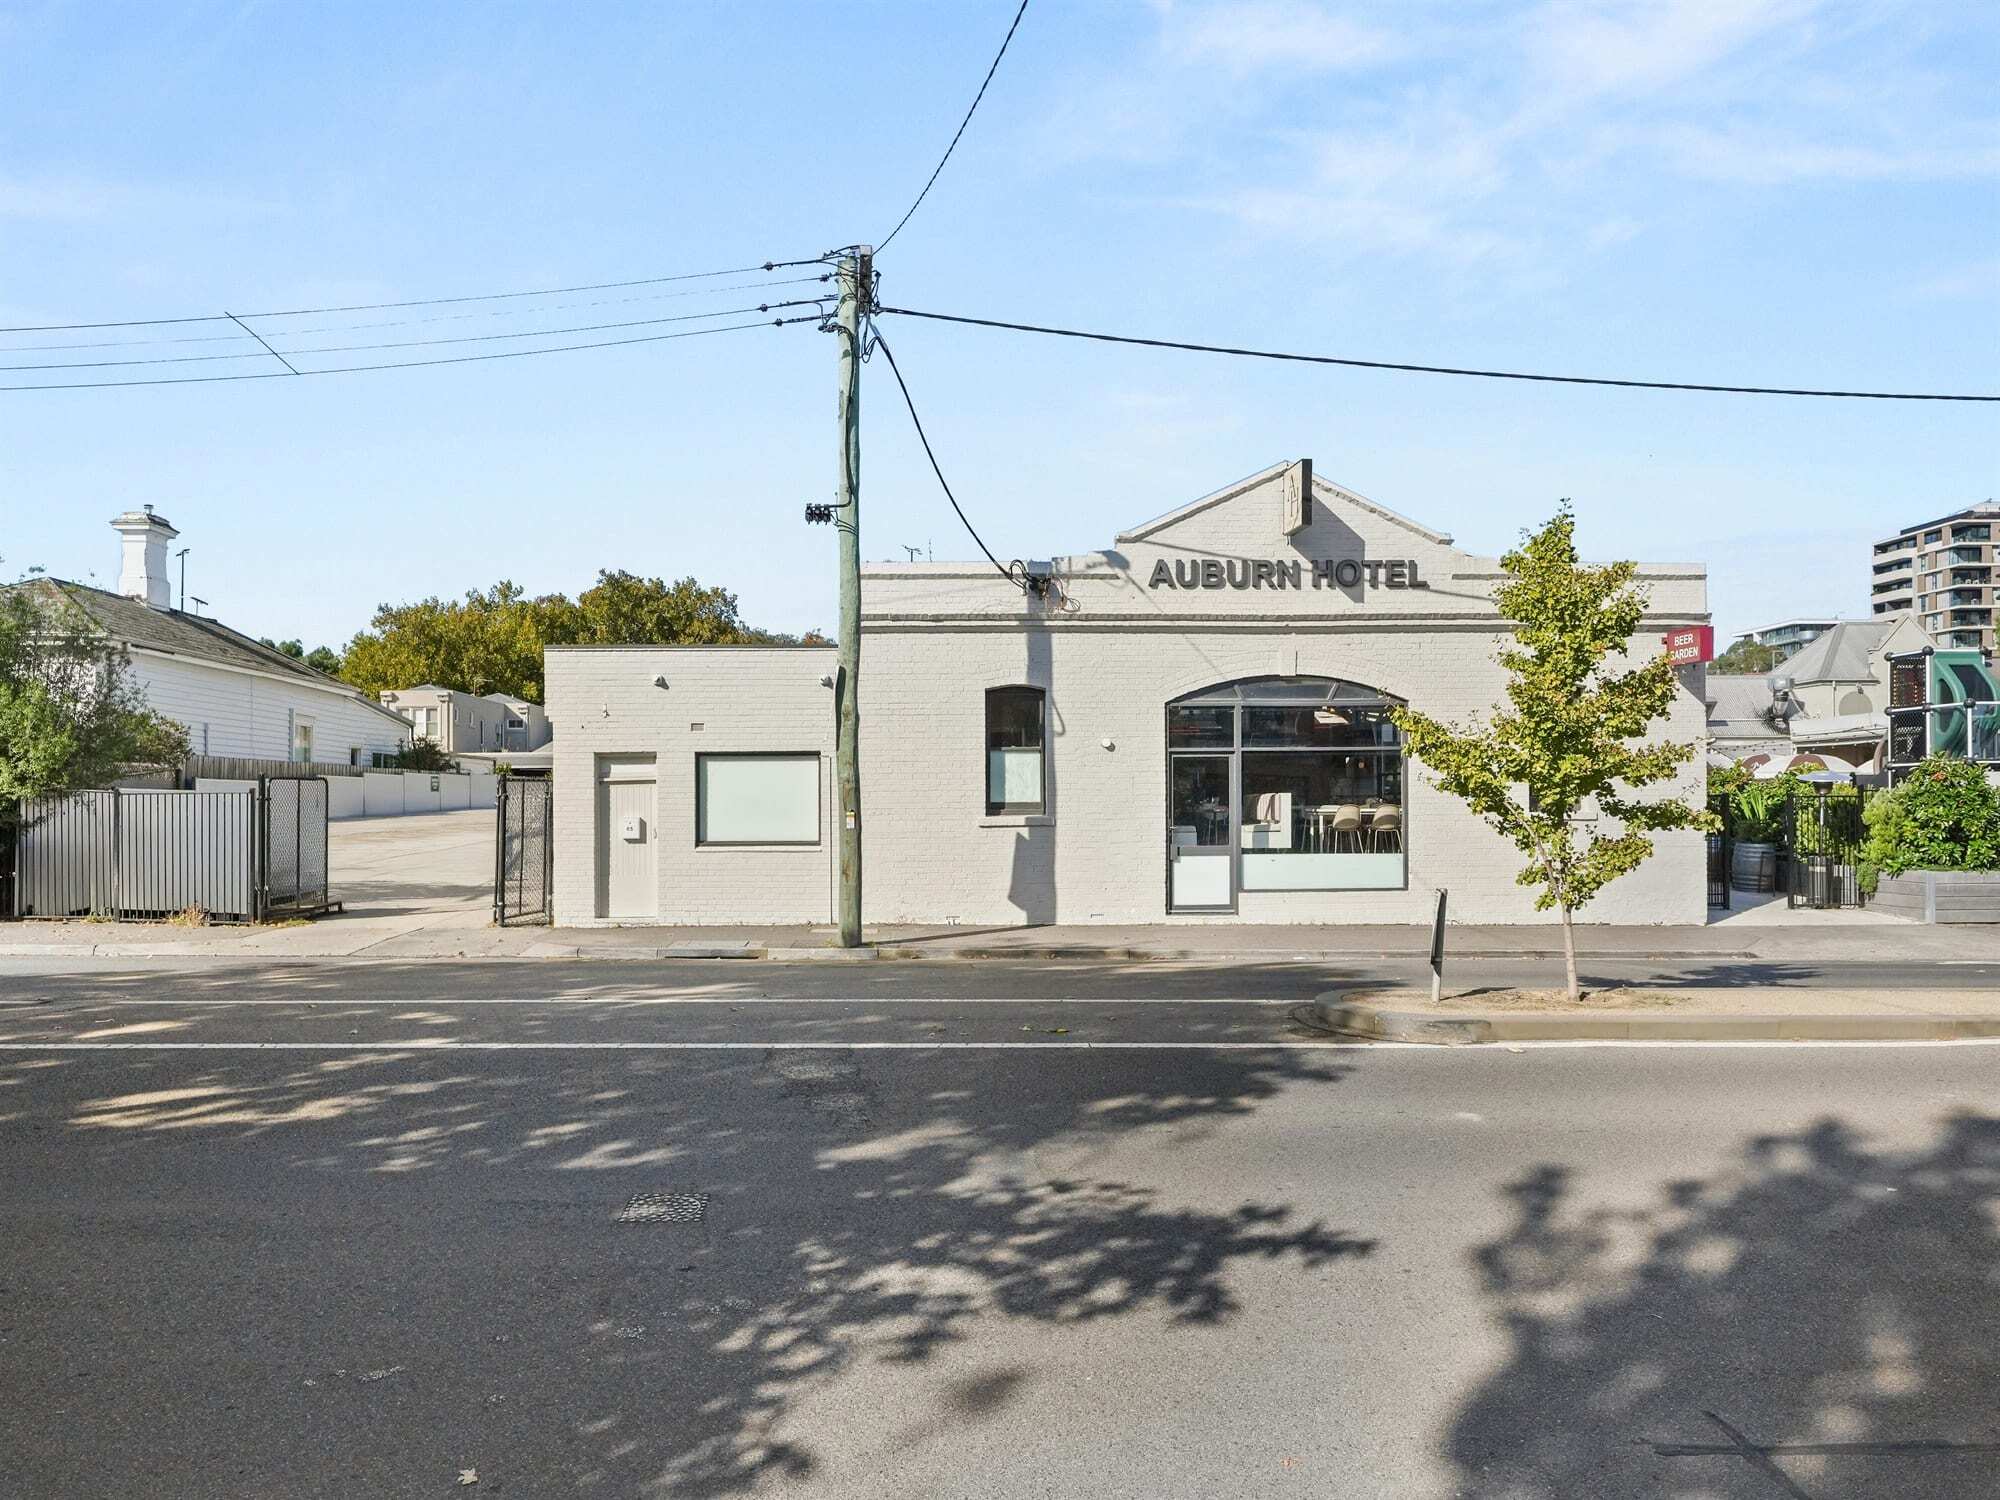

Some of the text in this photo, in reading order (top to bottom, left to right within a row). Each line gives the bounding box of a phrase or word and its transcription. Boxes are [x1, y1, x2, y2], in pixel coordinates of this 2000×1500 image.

[1149, 559, 1430, 590] AUBURN HOTEL
[1674, 633, 1694, 647] BEER
